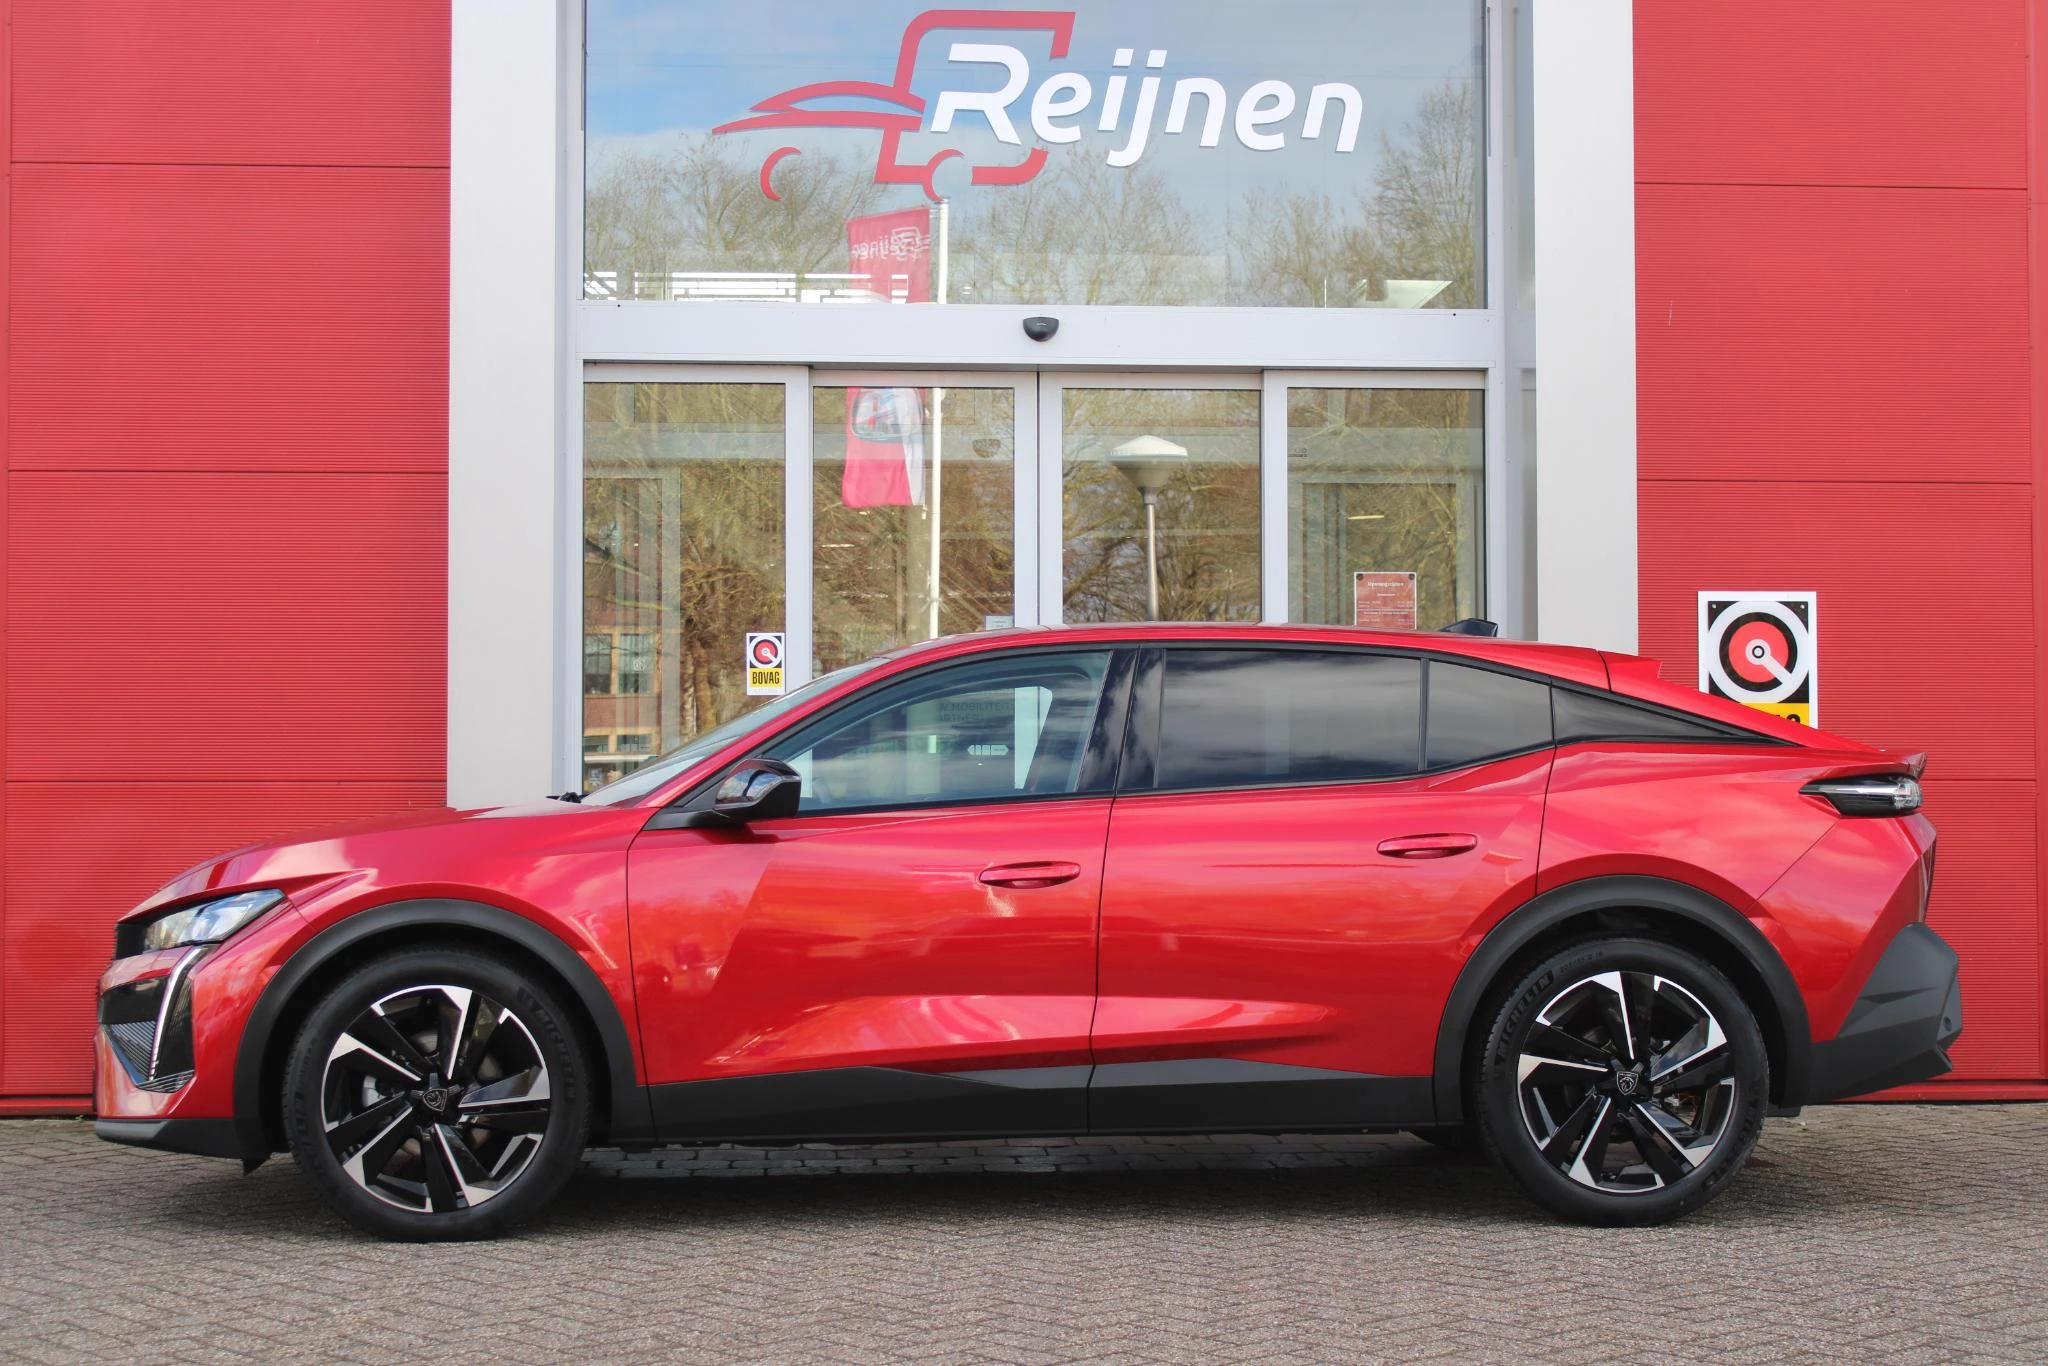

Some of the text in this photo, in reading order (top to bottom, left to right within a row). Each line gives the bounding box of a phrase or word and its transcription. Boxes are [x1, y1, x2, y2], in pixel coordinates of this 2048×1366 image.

[930, 43, 1363, 168] Reijnen
[751, 671, 780, 685] BOVAG
[1497, 972, 1552, 1058] MICHELIN
